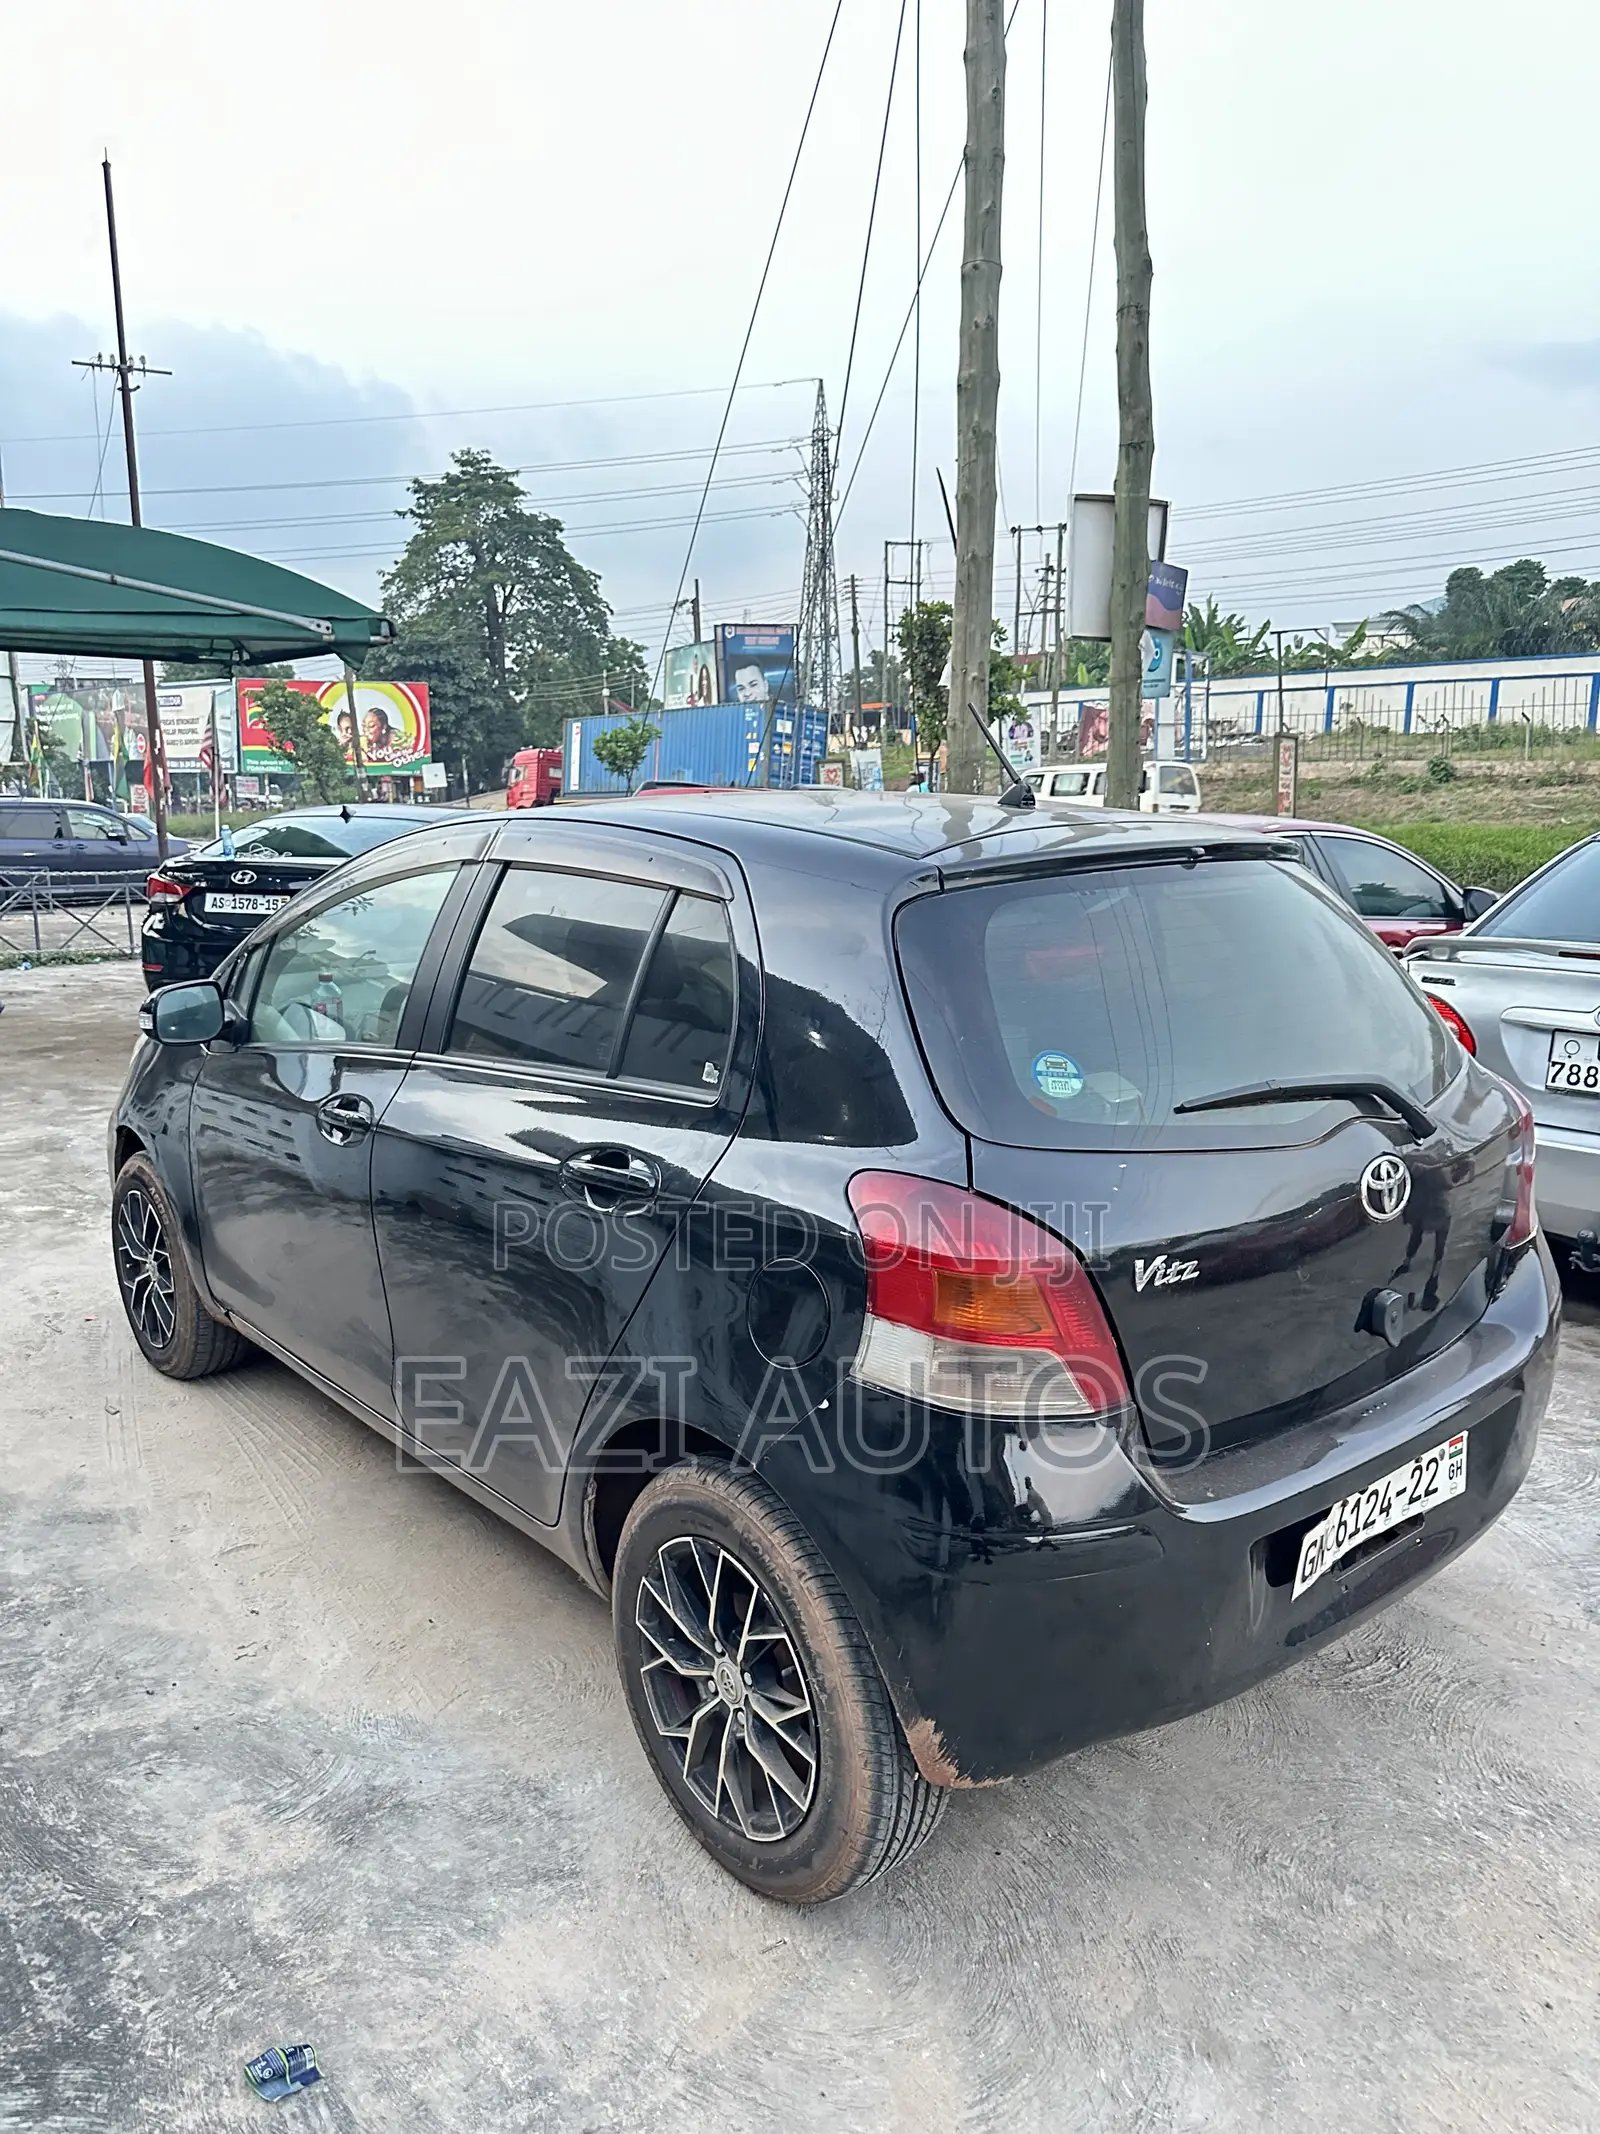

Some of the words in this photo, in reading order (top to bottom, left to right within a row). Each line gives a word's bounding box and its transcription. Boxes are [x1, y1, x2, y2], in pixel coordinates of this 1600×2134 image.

[211, 897, 225, 909] AS
[231, 898, 279, 911] 1578-15
[1134, 1254, 1200, 1292] Vitz
[1448, 1458, 1463, 1480] GH
[1336, 1457, 1439, 1548] 6124-22
